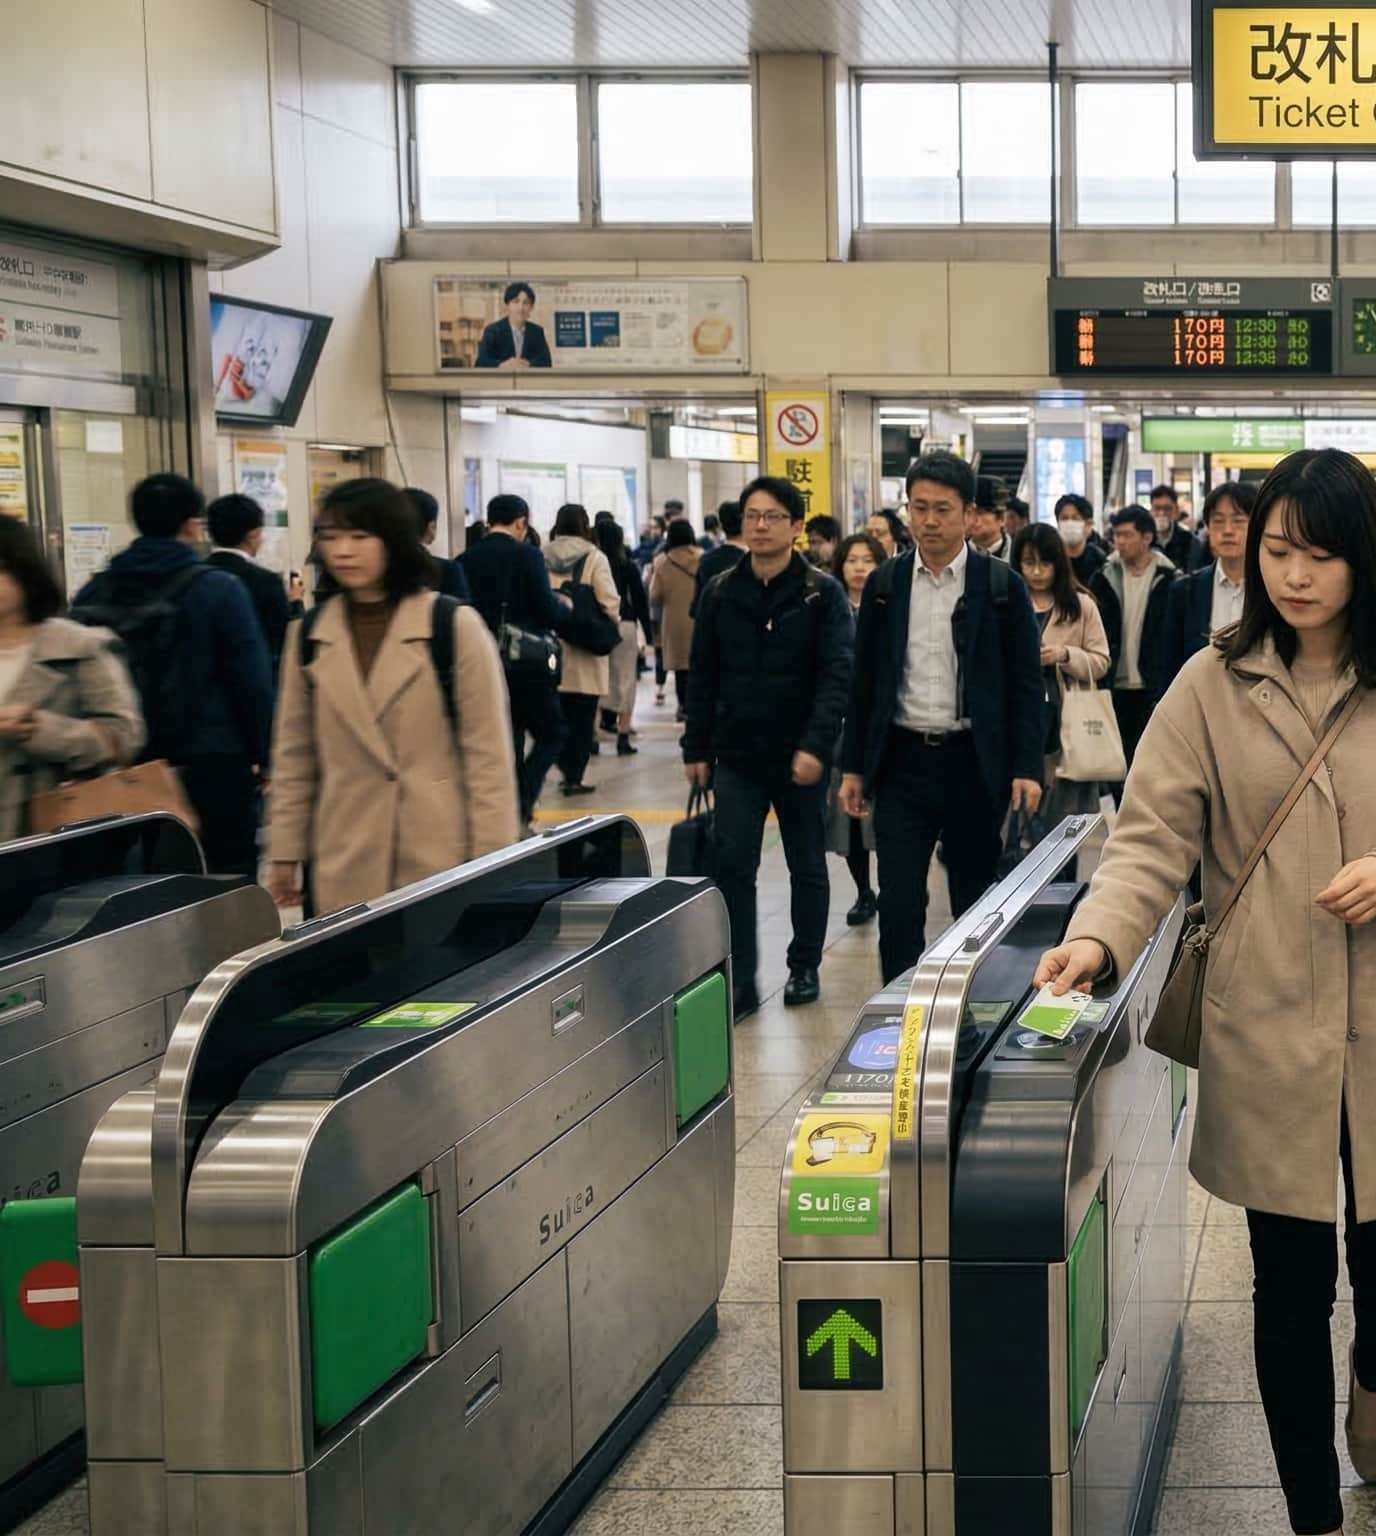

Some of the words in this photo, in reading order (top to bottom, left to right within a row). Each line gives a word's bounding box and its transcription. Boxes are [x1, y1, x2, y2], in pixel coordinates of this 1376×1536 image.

[1249, 95, 1360, 129] Ticket
[1173, 319, 1225, 334] 170円
[1173, 335, 1225, 349] 170円
[1173, 350, 1225, 365] 170円
[844, 1073, 895, 1085] 1170
[797, 1192, 872, 1213] Suica
[539, 1184, 594, 1245] Suica
